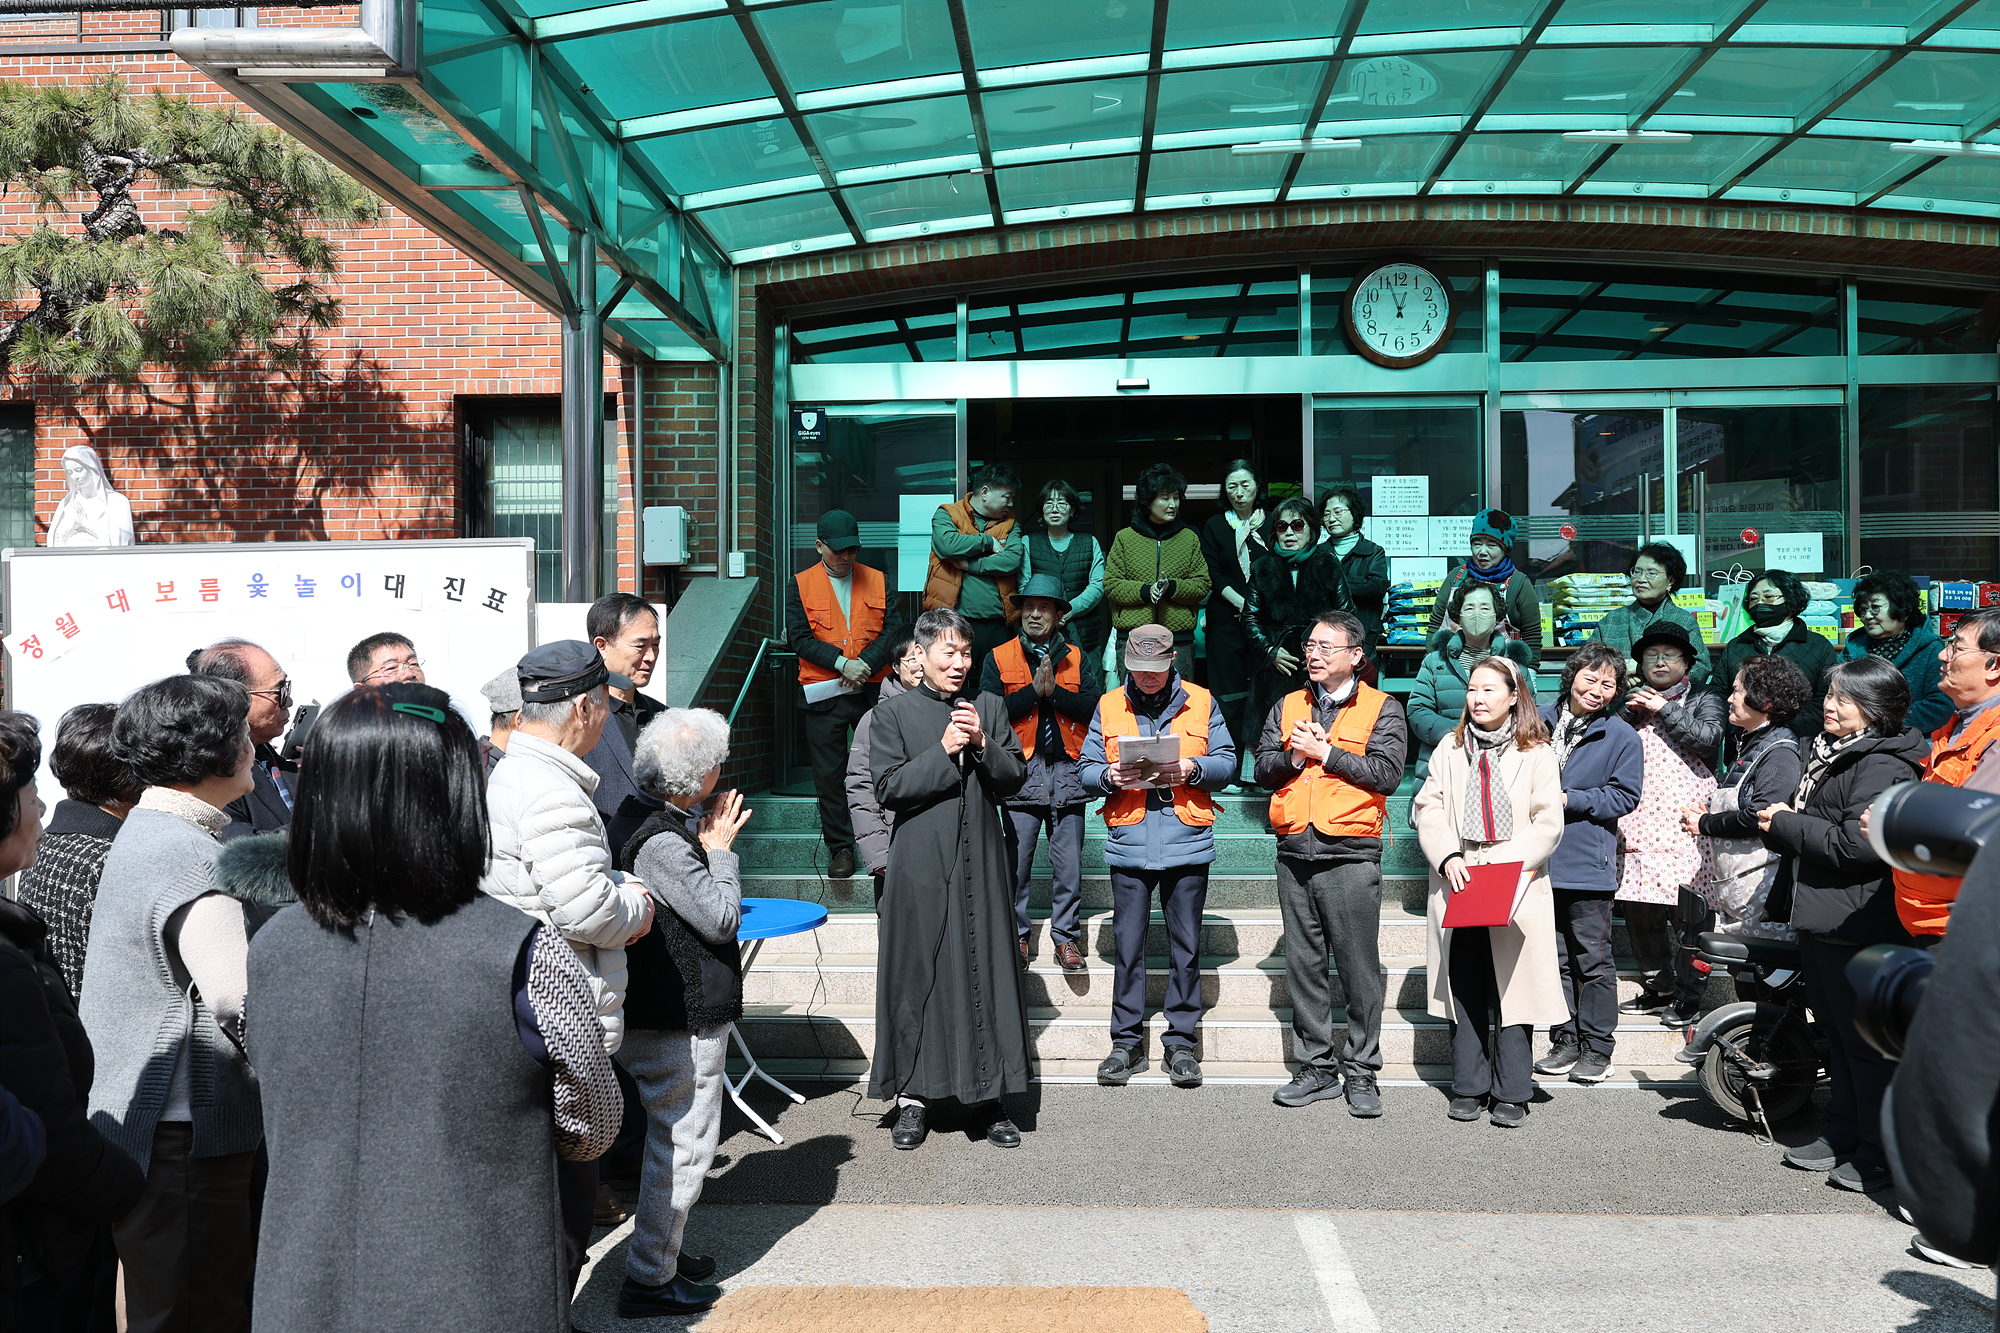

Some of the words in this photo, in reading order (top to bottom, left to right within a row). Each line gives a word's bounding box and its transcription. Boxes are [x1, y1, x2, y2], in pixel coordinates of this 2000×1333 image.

[1379, 276, 1389, 289] 11
[1393, 272, 1407, 286] 12
[1413, 276, 1419, 289] 1
[1366, 288, 1379, 303] 10
[1423, 287, 1433, 301] 2
[1362, 304, 1372, 319] 9
[1428, 303, 1438, 318] 3
[1367, 320, 1377, 335] 8
[1421, 320, 1432, 334] 4
[1379, 333, 1388, 347] 7
[1394, 336, 1405, 351] 6
[1410, 333, 1420, 347] 5
